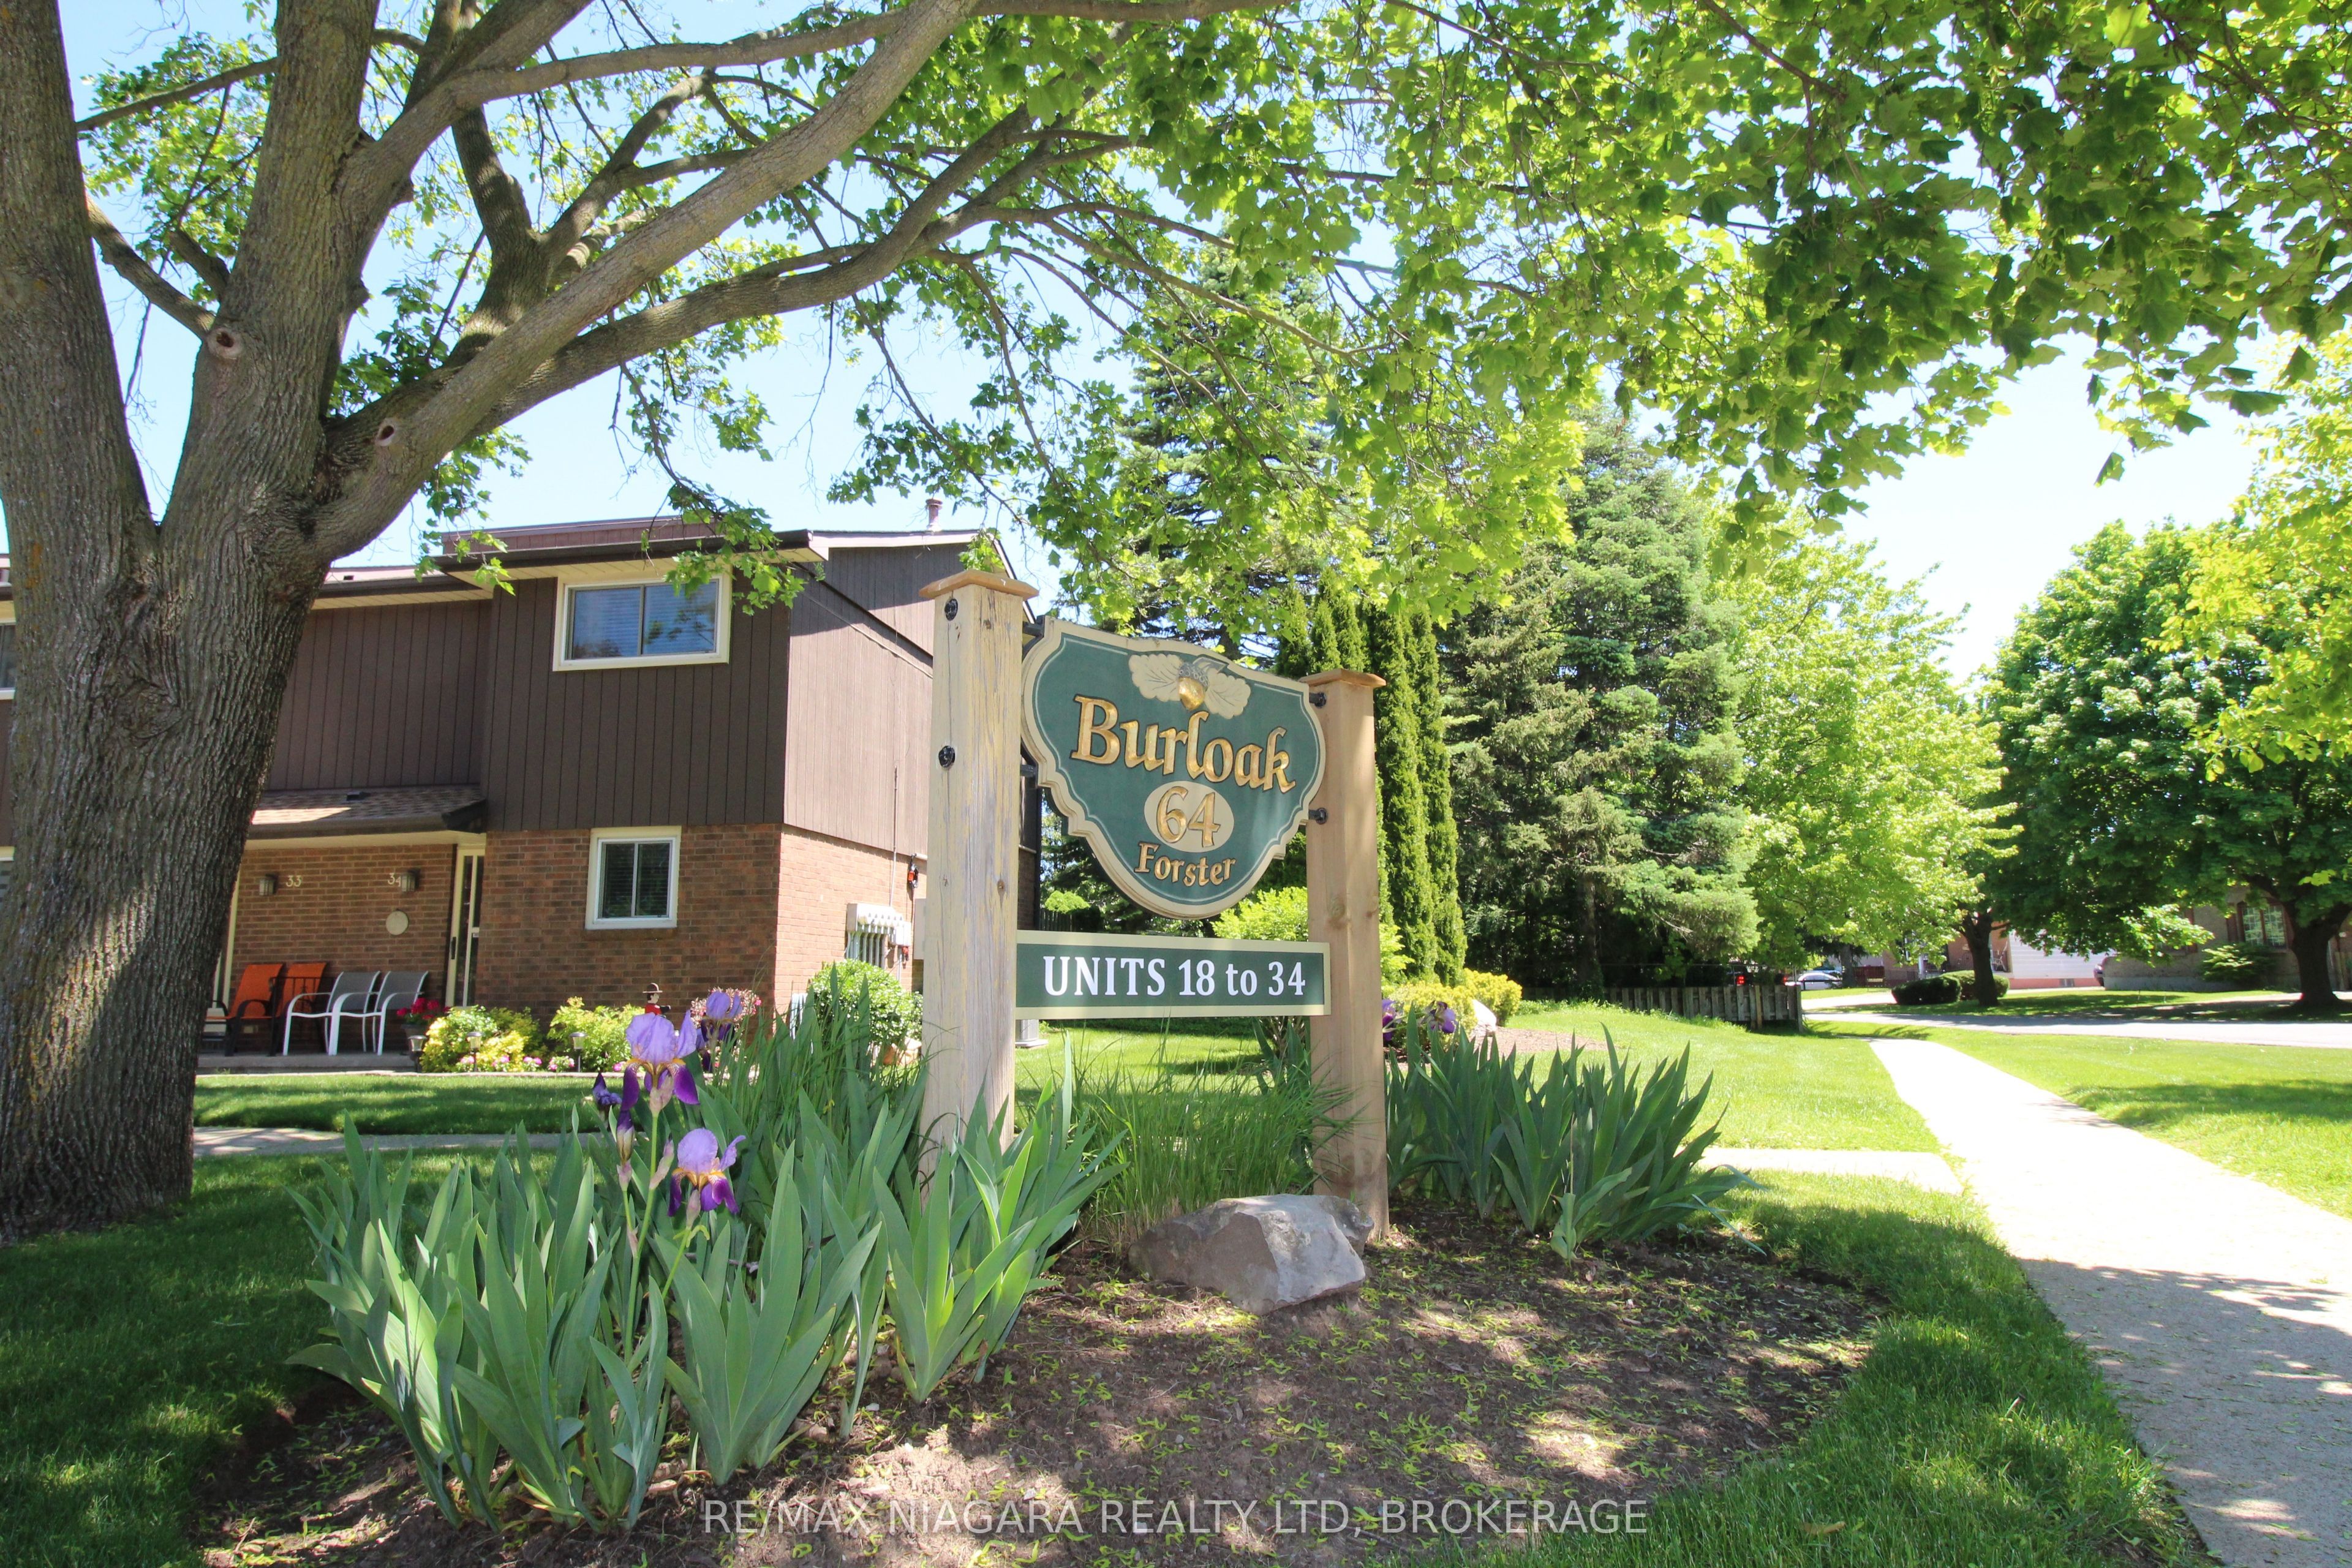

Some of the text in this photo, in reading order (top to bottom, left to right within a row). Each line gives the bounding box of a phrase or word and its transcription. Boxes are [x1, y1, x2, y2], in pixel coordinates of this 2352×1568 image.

[1070, 694, 1297, 794] Burloak
[1156, 786, 1221, 848] 64
[285, 875, 301, 887] 33
[387, 872, 402, 888] 34
[1134, 840, 1236, 887] Forster
[1043, 956, 1305, 996] UNITS 18 to 34
